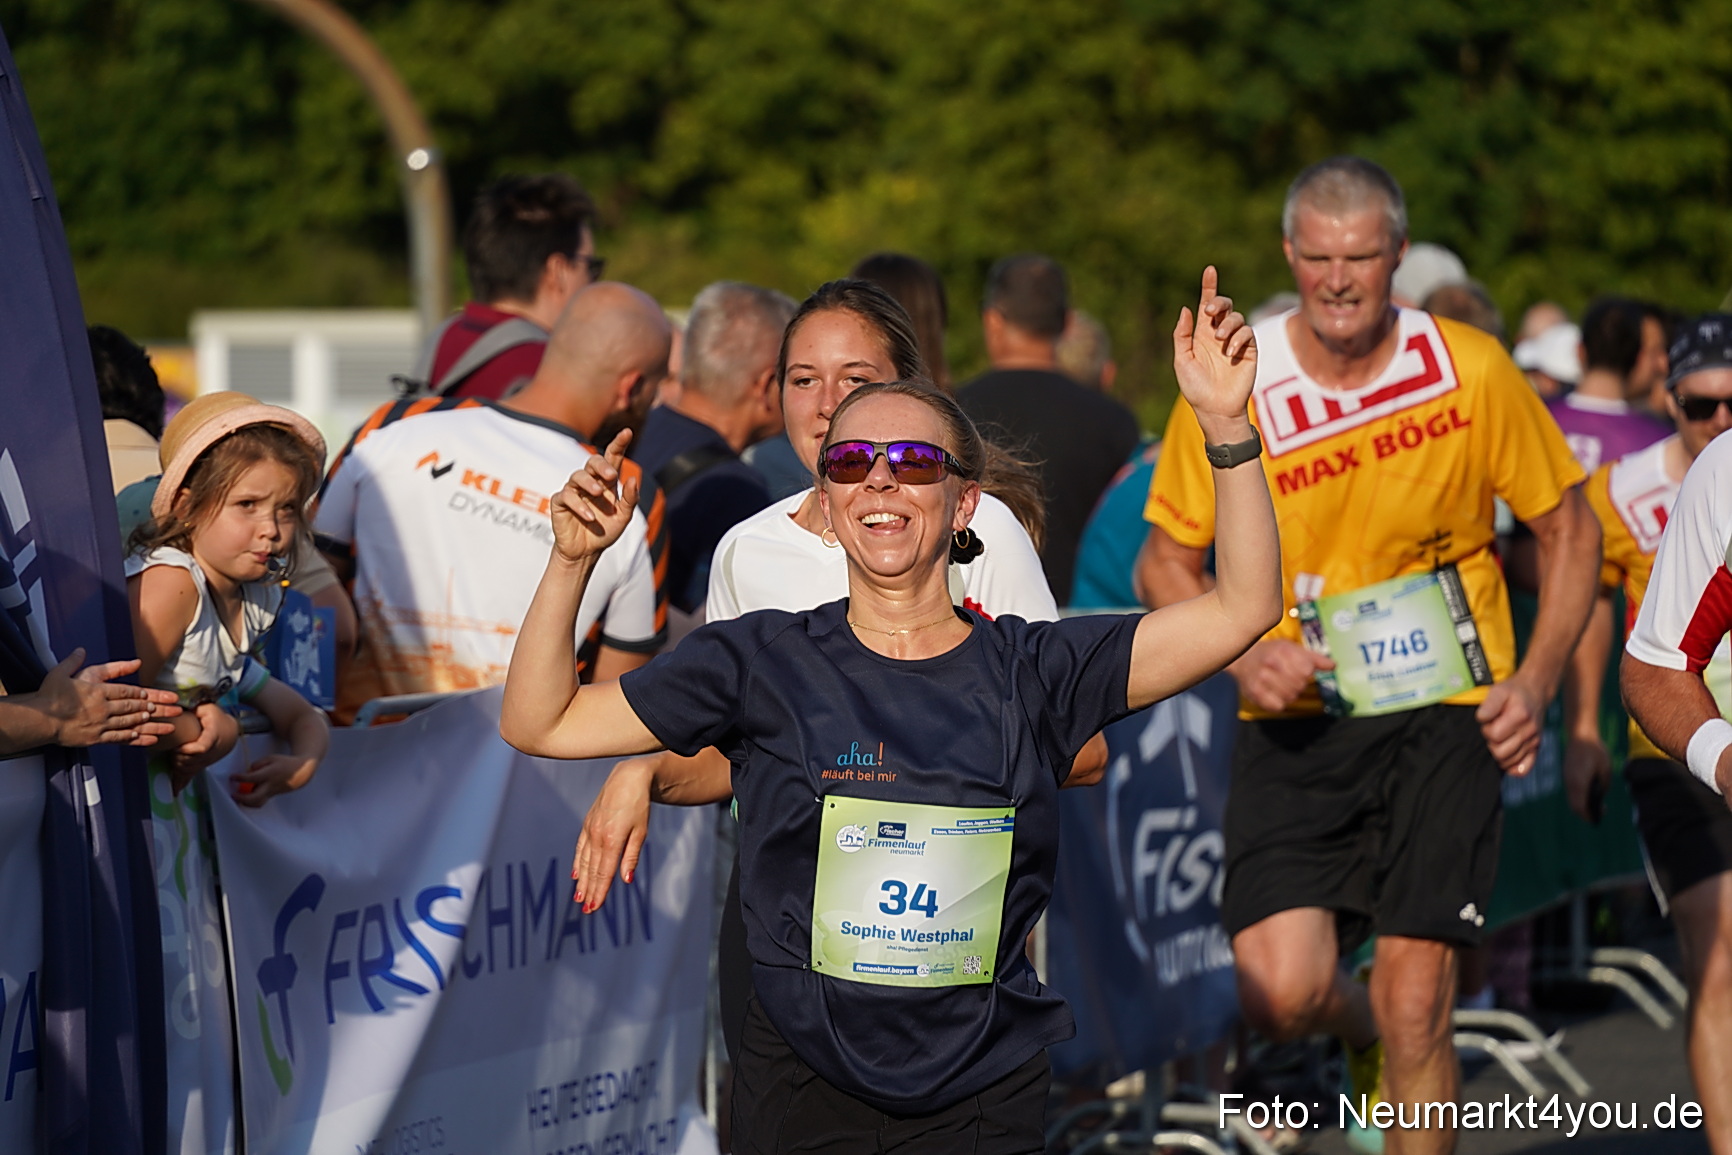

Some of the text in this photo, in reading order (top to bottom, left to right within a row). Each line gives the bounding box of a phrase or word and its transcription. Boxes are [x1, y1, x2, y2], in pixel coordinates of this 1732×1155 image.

[1275, 407, 1472, 497] MAX BÖGL
[1359, 629, 1430, 665] 1746
[837, 741, 884, 767] aha!
[821, 769, 897, 782] #läuft bei mir
[867, 838, 927, 851] Firmenlauf
[889, 848, 925, 857] neumarkt
[878, 879, 939, 919] 34
[840, 920, 974, 946] Sophie Westphal
[855, 964, 915, 975] firmenlauf.bayern
